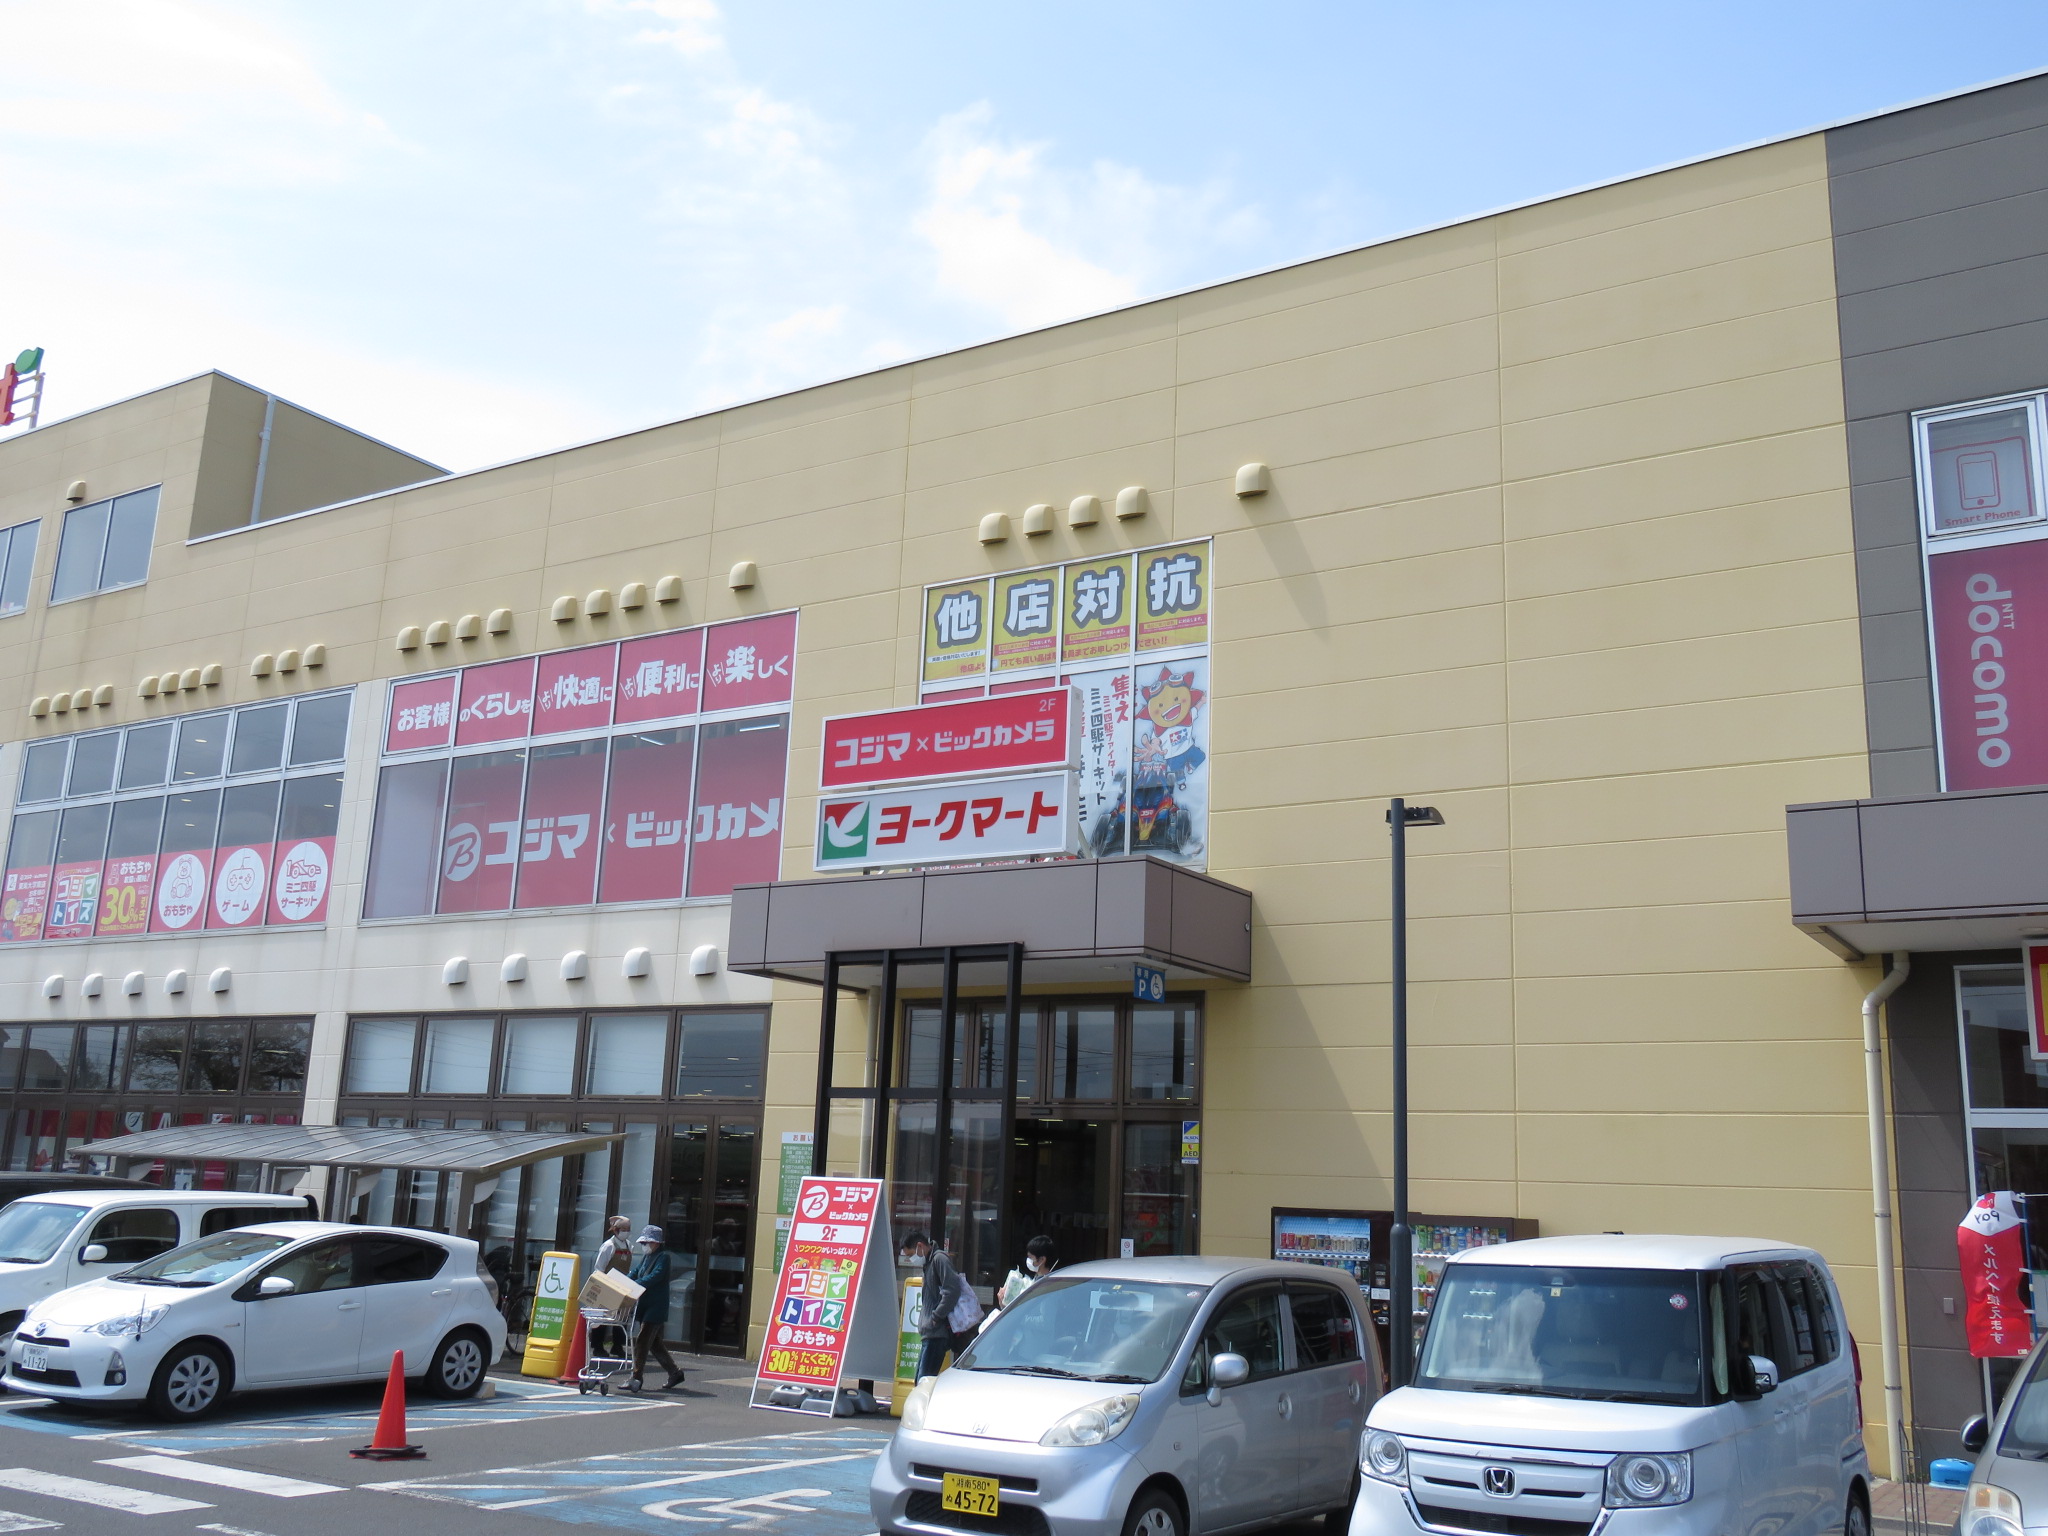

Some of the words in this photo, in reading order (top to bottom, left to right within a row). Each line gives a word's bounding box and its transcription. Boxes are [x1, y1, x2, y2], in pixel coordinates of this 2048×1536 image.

[1944, 513, 1981, 527] Smart
[1983, 509, 2021, 521] Phone
[2001, 603, 2015, 630] NTT
[1965, 572, 2012, 769] docomo
[1039, 698, 1056, 712] 2F
[1091, 688, 1106, 806] ミニ四駆サーキット
[875, 791, 1059, 845] ヨークマート
[120, 861, 152, 875] おもちゃ
[58, 878, 97, 898] コジマ
[286, 881, 317, 893] ミニ四駆
[163, 904, 193, 917] おもちゃ
[222, 900, 250, 913] ゲーム
[281, 897, 318, 909] サーキット
[1138, 979, 1146, 997] P
[833, 1186, 874, 1203] コジマ
[829, 1211, 869, 1221] ビックカメラ
[821, 1225, 838, 1241] 2F
[790, 1273, 847, 1295] コジマ
[784, 1300, 842, 1325] トイズ
[792, 1330, 836, 1347] おもちゃ
[28, 1356, 46, 1369] 11-22
[800, 1351, 836, 1367] たくさん
[797, 1364, 831, 1377] あります!
[973, 1480, 987, 1490] 580
[954, 1490, 996, 1513] 45-72
